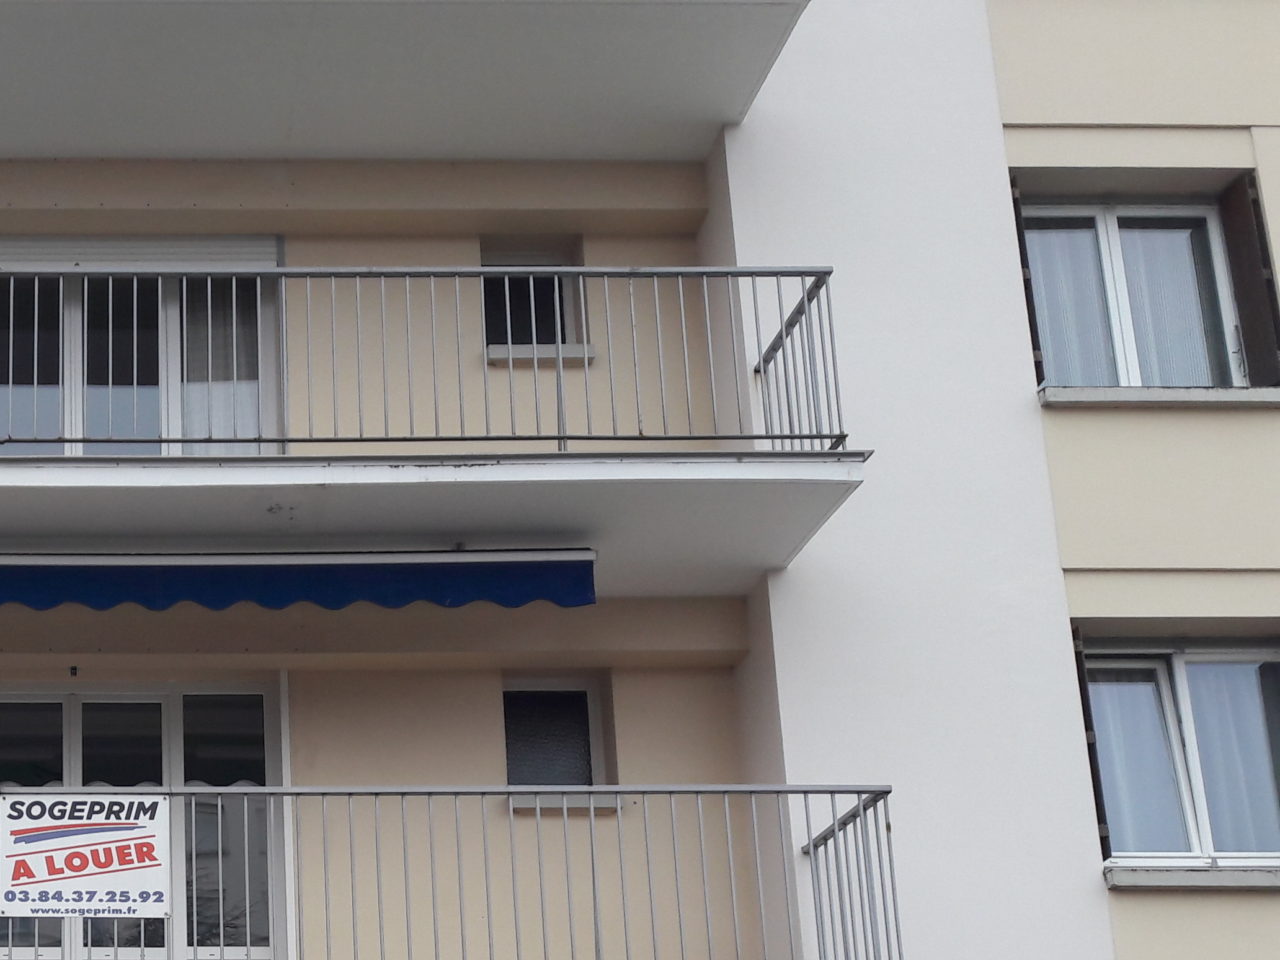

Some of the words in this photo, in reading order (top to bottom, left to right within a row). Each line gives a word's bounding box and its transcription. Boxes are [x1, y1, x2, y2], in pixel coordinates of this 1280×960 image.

[7, 800, 159, 820] SOGEPRIM
[11, 859, 36, 881] A
[45, 841, 159, 876] LOUER
[4, 890, 164, 903] 03.84.37.25.92
[30, 906, 138, 916] www.sogeprim.fr
